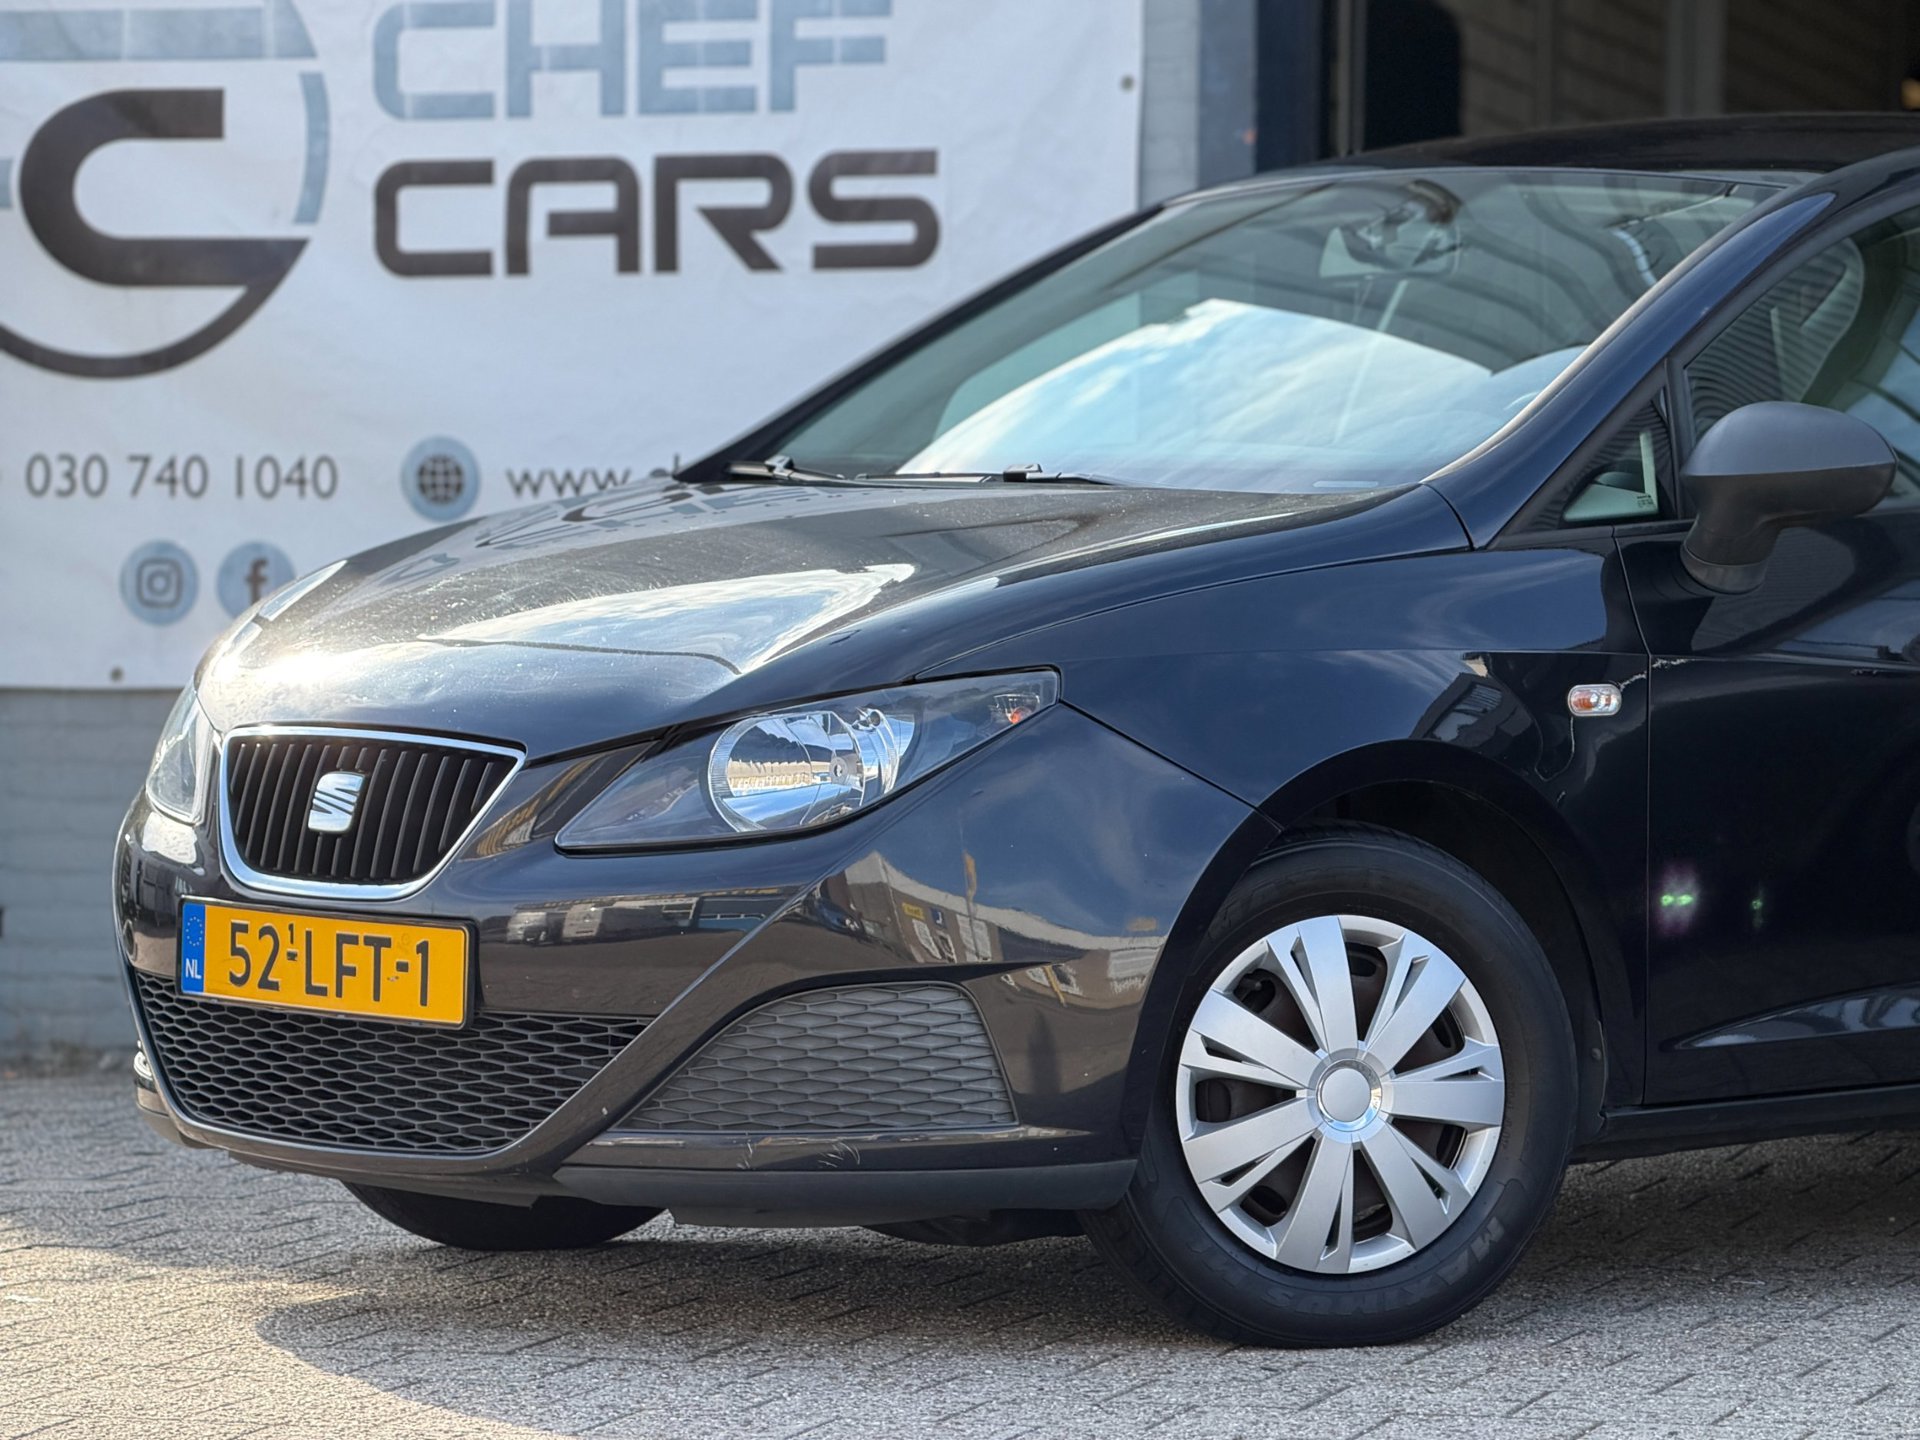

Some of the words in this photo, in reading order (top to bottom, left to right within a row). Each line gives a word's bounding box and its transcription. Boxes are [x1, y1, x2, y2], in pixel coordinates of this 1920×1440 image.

[373, 0, 893, 119] CHEF
[374, 148, 940, 277] CARS
[25, 454, 108, 498] 030
[127, 455, 209, 498] 740
[235, 455, 338, 499] 1040
[185, 958, 202, 979] NL
[1260, 1216, 1506, 1315] MAXIMUS
